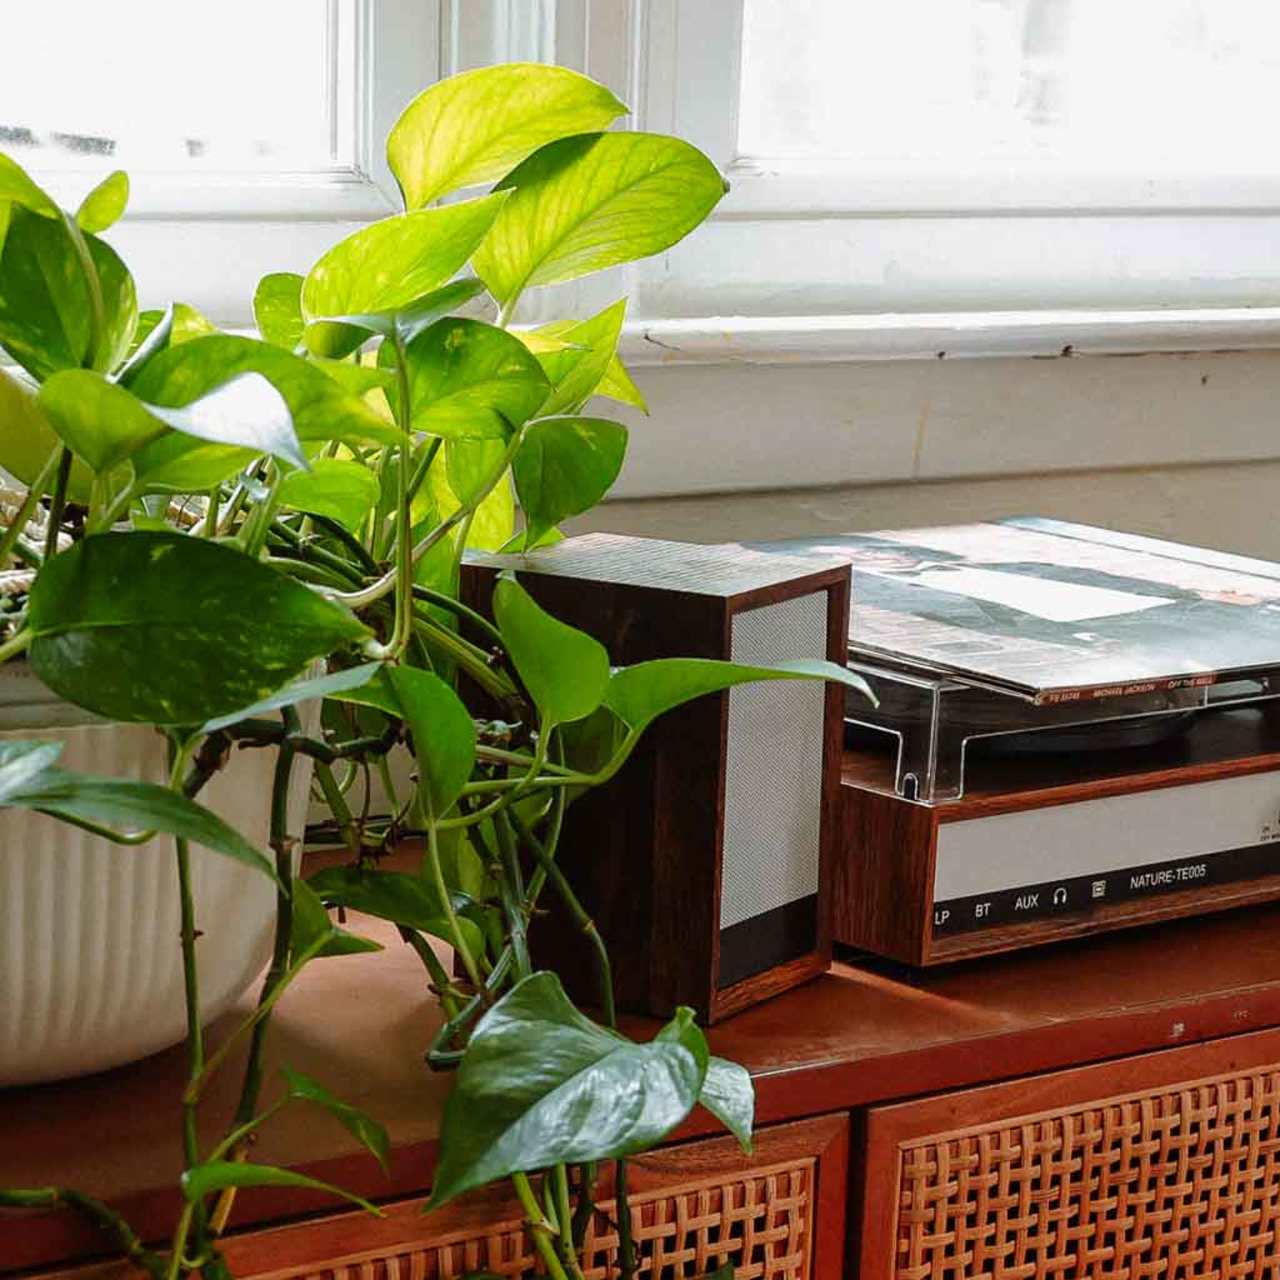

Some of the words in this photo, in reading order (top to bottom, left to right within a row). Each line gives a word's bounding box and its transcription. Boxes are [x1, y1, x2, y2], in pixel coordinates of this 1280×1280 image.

[1124, 684, 1156, 695] JACKSON
[1167, 679, 1182, 689] OFF
[934, 910, 951, 926] LP
[975, 903, 992, 918] BT
[1014, 894, 1040, 911] AUX
[1130, 864, 1207, 889] NATURE-TE005
